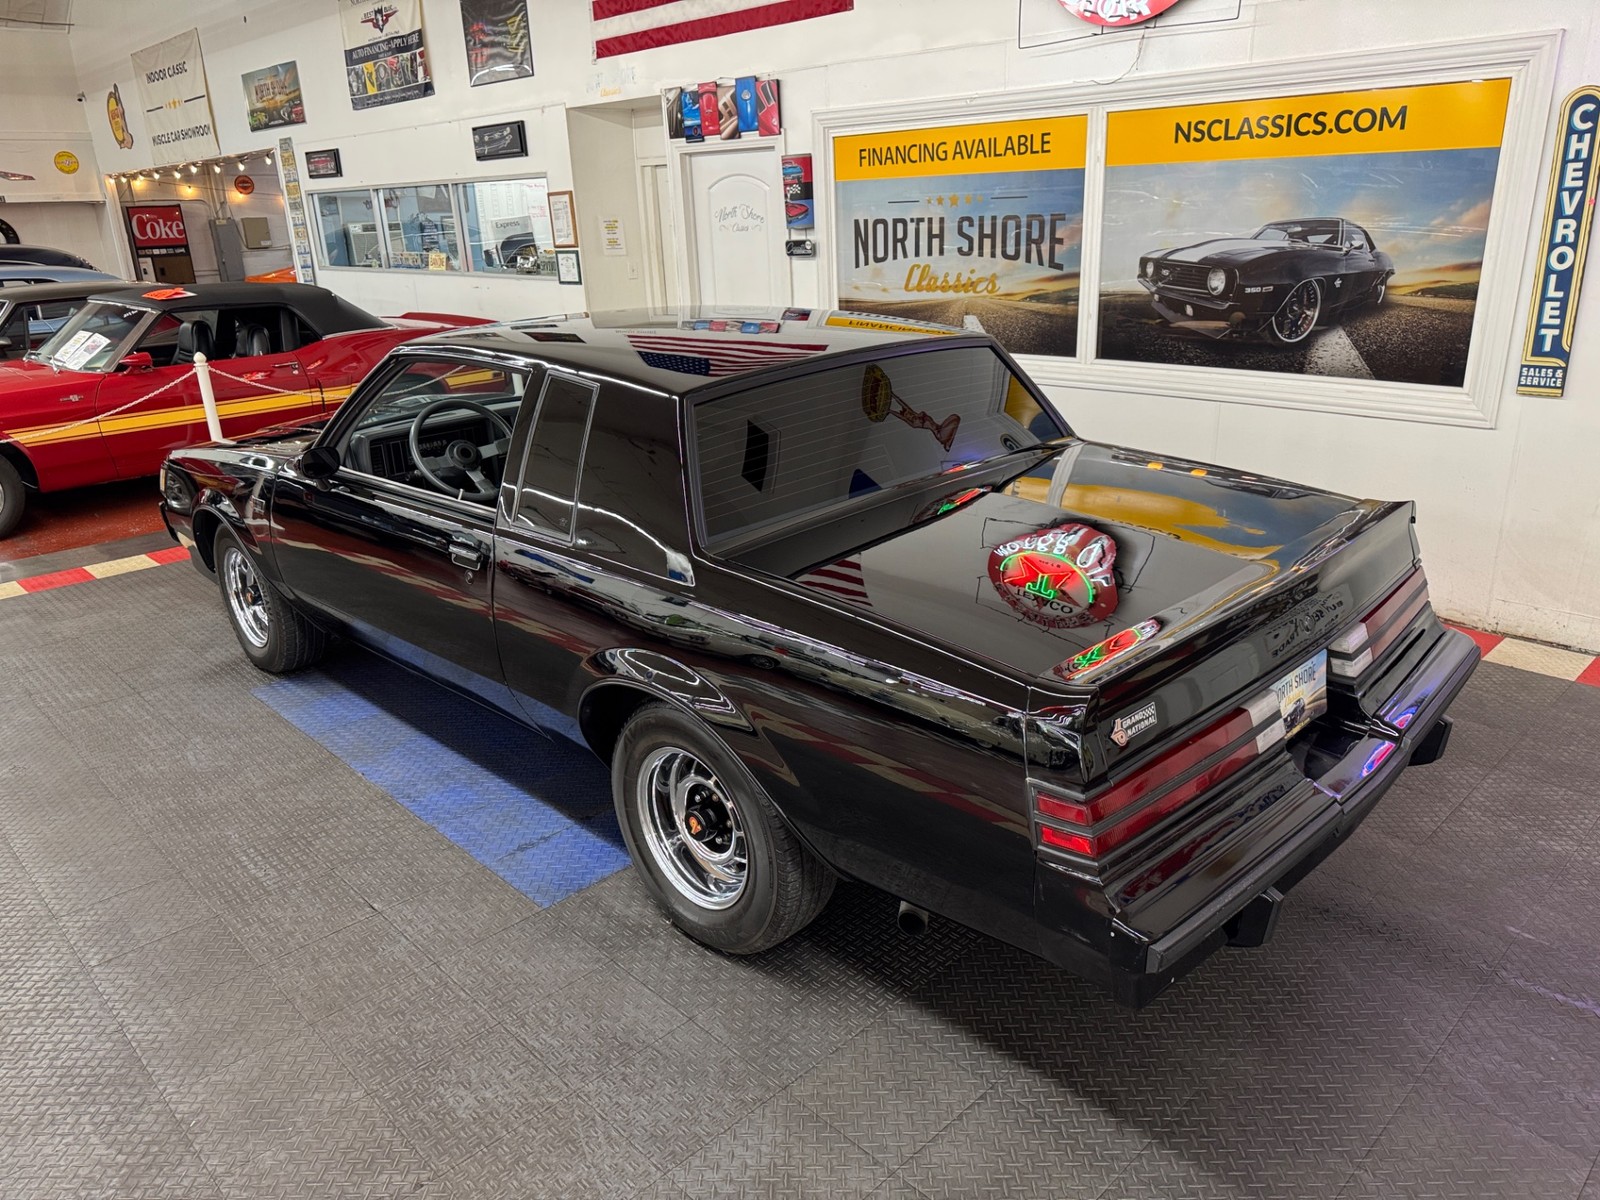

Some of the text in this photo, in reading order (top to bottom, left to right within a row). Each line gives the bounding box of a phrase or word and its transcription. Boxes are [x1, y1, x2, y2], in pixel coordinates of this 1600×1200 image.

[407, 32, 419, 43] HERE
[145, 61, 188, 84] INDOOR CLASSIC
[151, 123, 212, 147] MUSCLE CAR SHOWROOM
[1174, 105, 1408, 144] NSCLASSICS.COM
[859, 132, 1052, 167] FINANCING AVAILABLE
[495, 219, 521, 230] Express
[715, 203, 765, 224] North Shore
[131, 213, 186, 240] Coke
[1538, 102, 1597, 353] CHEVROLET
[853, 213, 1067, 272] NORTH SHORE
[903, 263, 1001, 294] Classics
[1520, 376, 1563, 387] SERVICE
[1521, 367, 1563, 378] SALES &
[1277, 663, 1317, 704] ORTH SHORE
[1122, 711, 1144, 729] GRAND
[1127, 715, 1156, 737] NATIONAL
